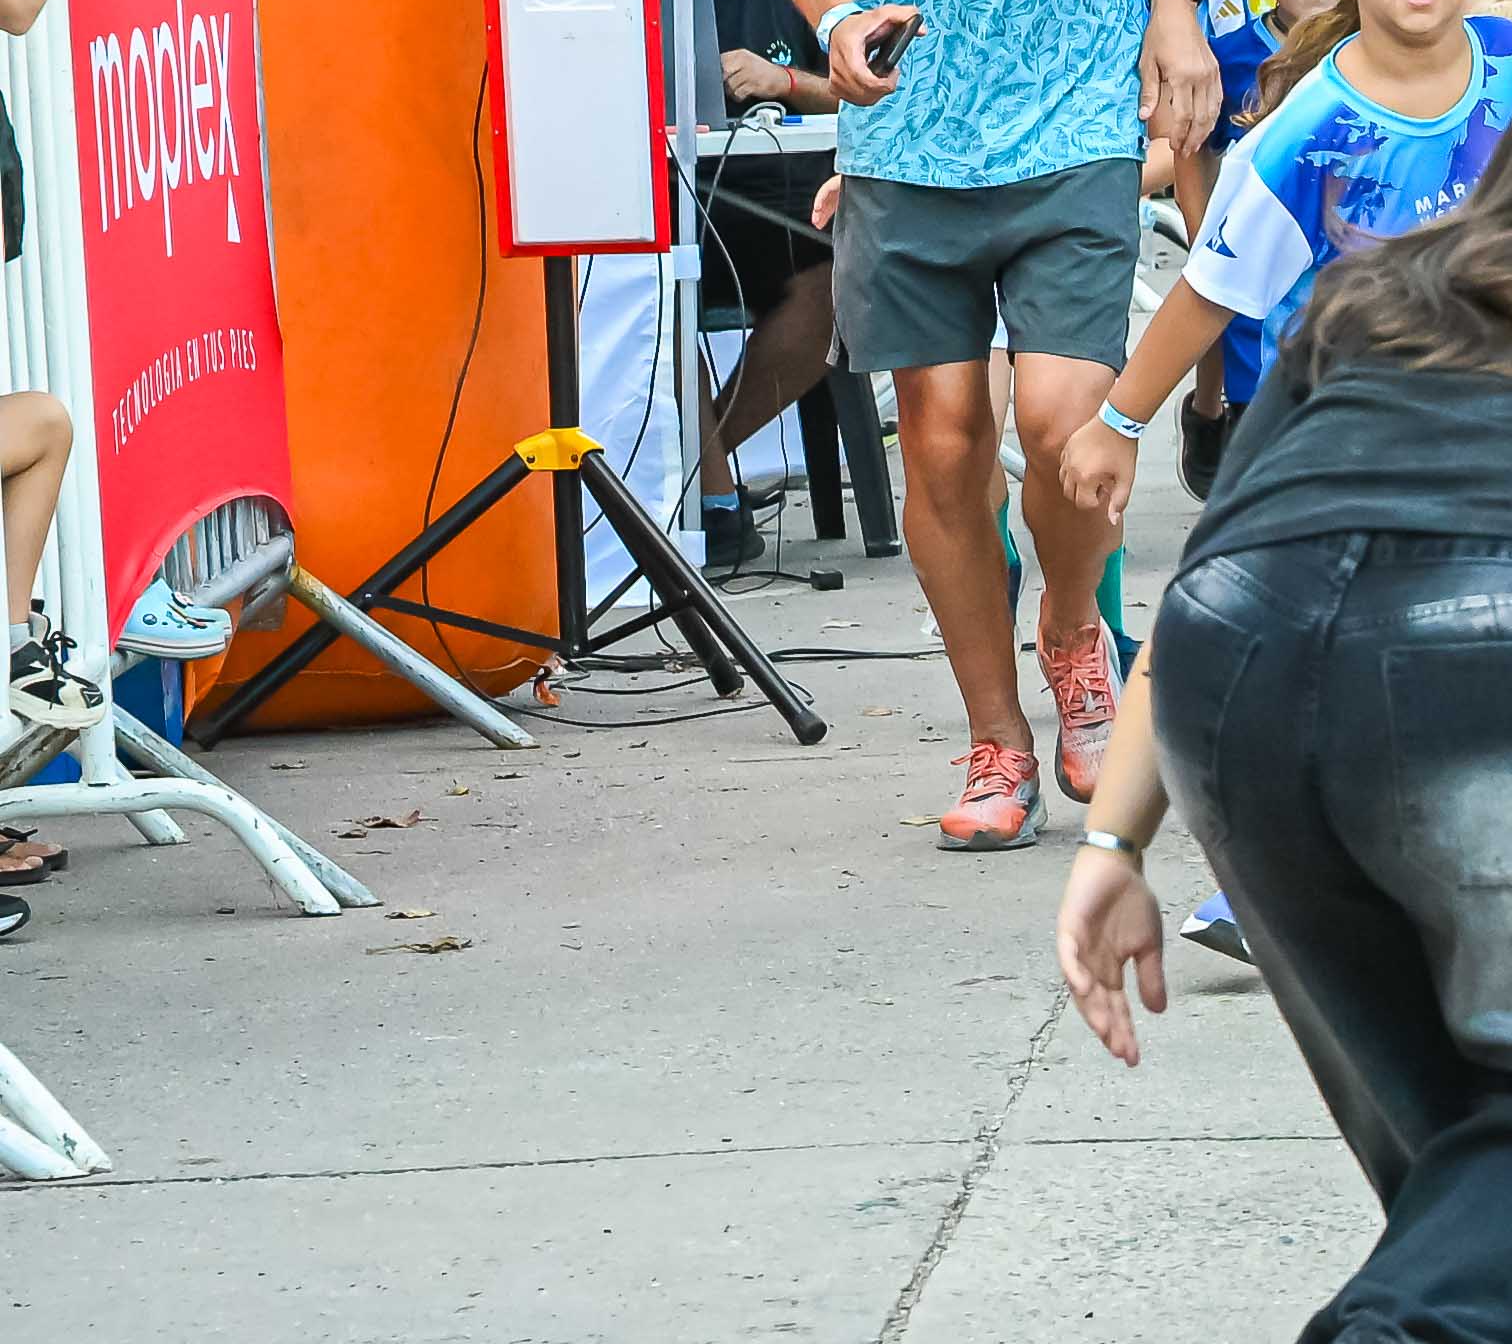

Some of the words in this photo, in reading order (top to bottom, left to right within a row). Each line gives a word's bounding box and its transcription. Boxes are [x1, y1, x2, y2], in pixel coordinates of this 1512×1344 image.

[112, 344, 183, 455] TECNOLOGIA
[187, 340, 201, 383] EN
[204, 331, 225, 372] TUS
[230, 330, 257, 372] PIES
